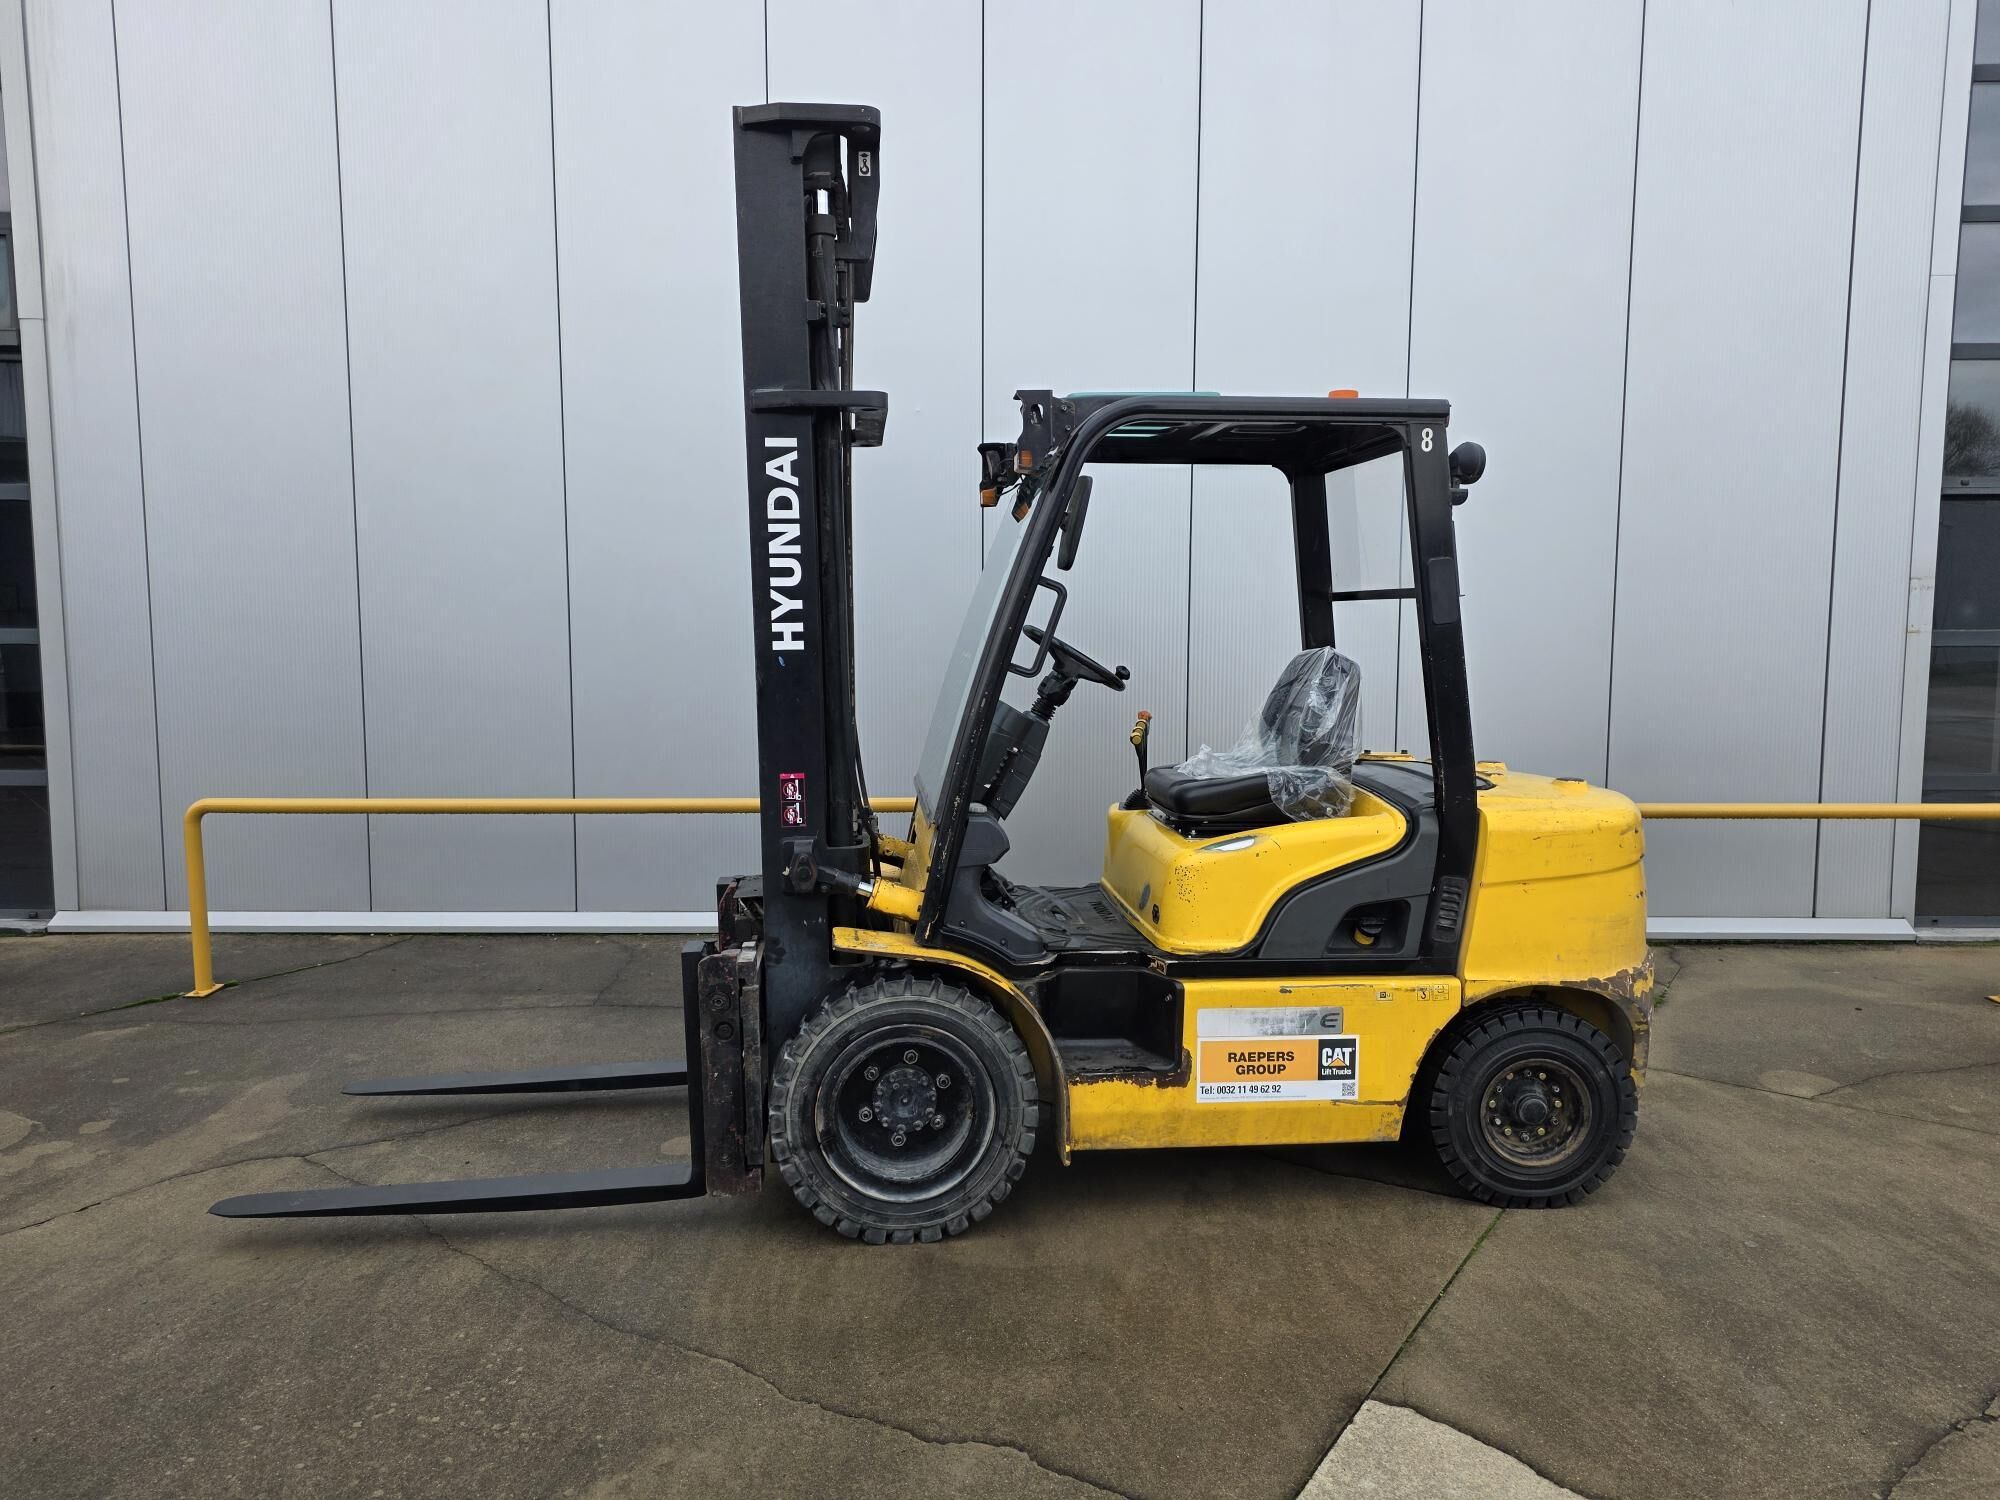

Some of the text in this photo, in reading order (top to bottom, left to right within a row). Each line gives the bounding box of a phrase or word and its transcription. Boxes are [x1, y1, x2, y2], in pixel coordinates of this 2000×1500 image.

[1421, 427, 1433, 452] 8
[764, 437, 805, 651] HYUNDAI
[1228, 1051, 1295, 1063] RAEPERS
[1321, 1047, 1352, 1067] CAT
[1236, 1064, 1287, 1075] GROUP
[1321, 1067, 1352, 1076] Lift Trucks
[1200, 1084, 1282, 1095] Tel: 0032 11 49 62 92
